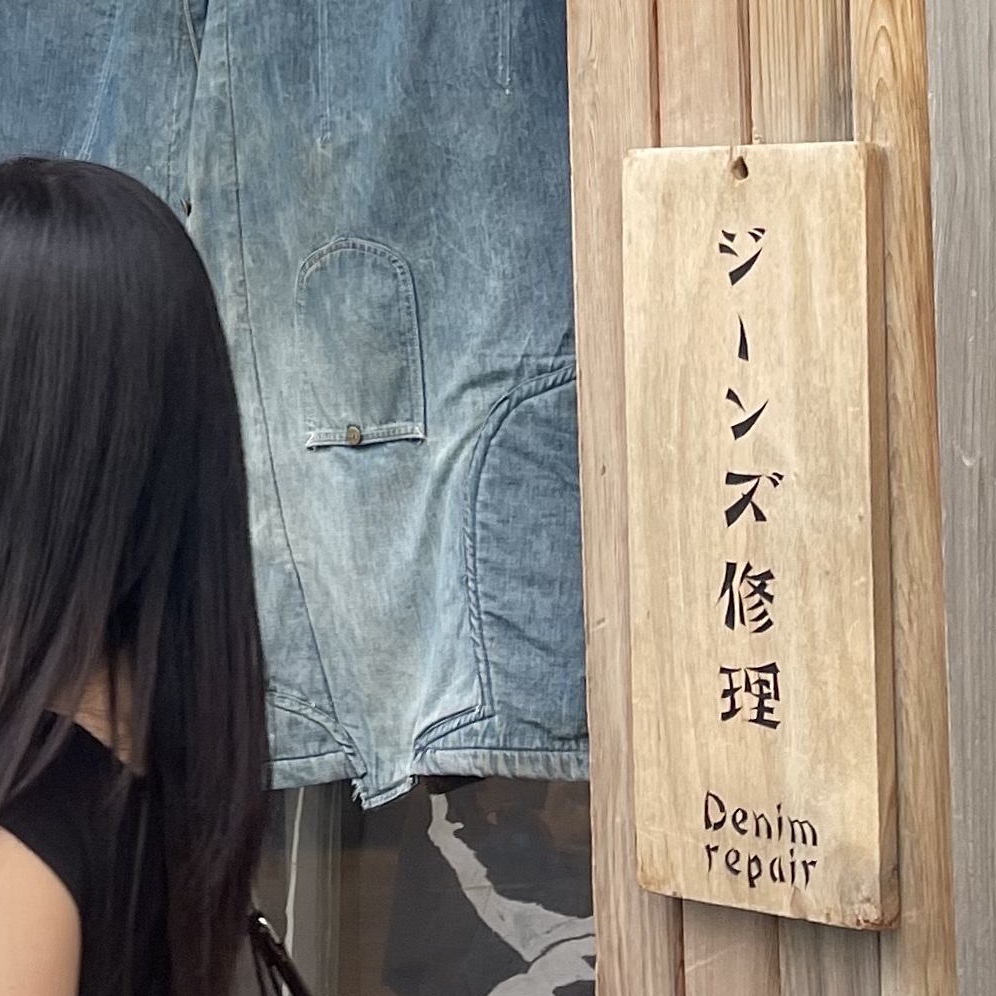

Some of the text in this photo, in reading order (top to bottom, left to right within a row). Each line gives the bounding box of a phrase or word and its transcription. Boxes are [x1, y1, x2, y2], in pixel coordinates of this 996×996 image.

[715, 227, 785, 731] ジーンズ修理
[704, 790, 818, 847] Denim
[705, 843, 818, 890] repair
